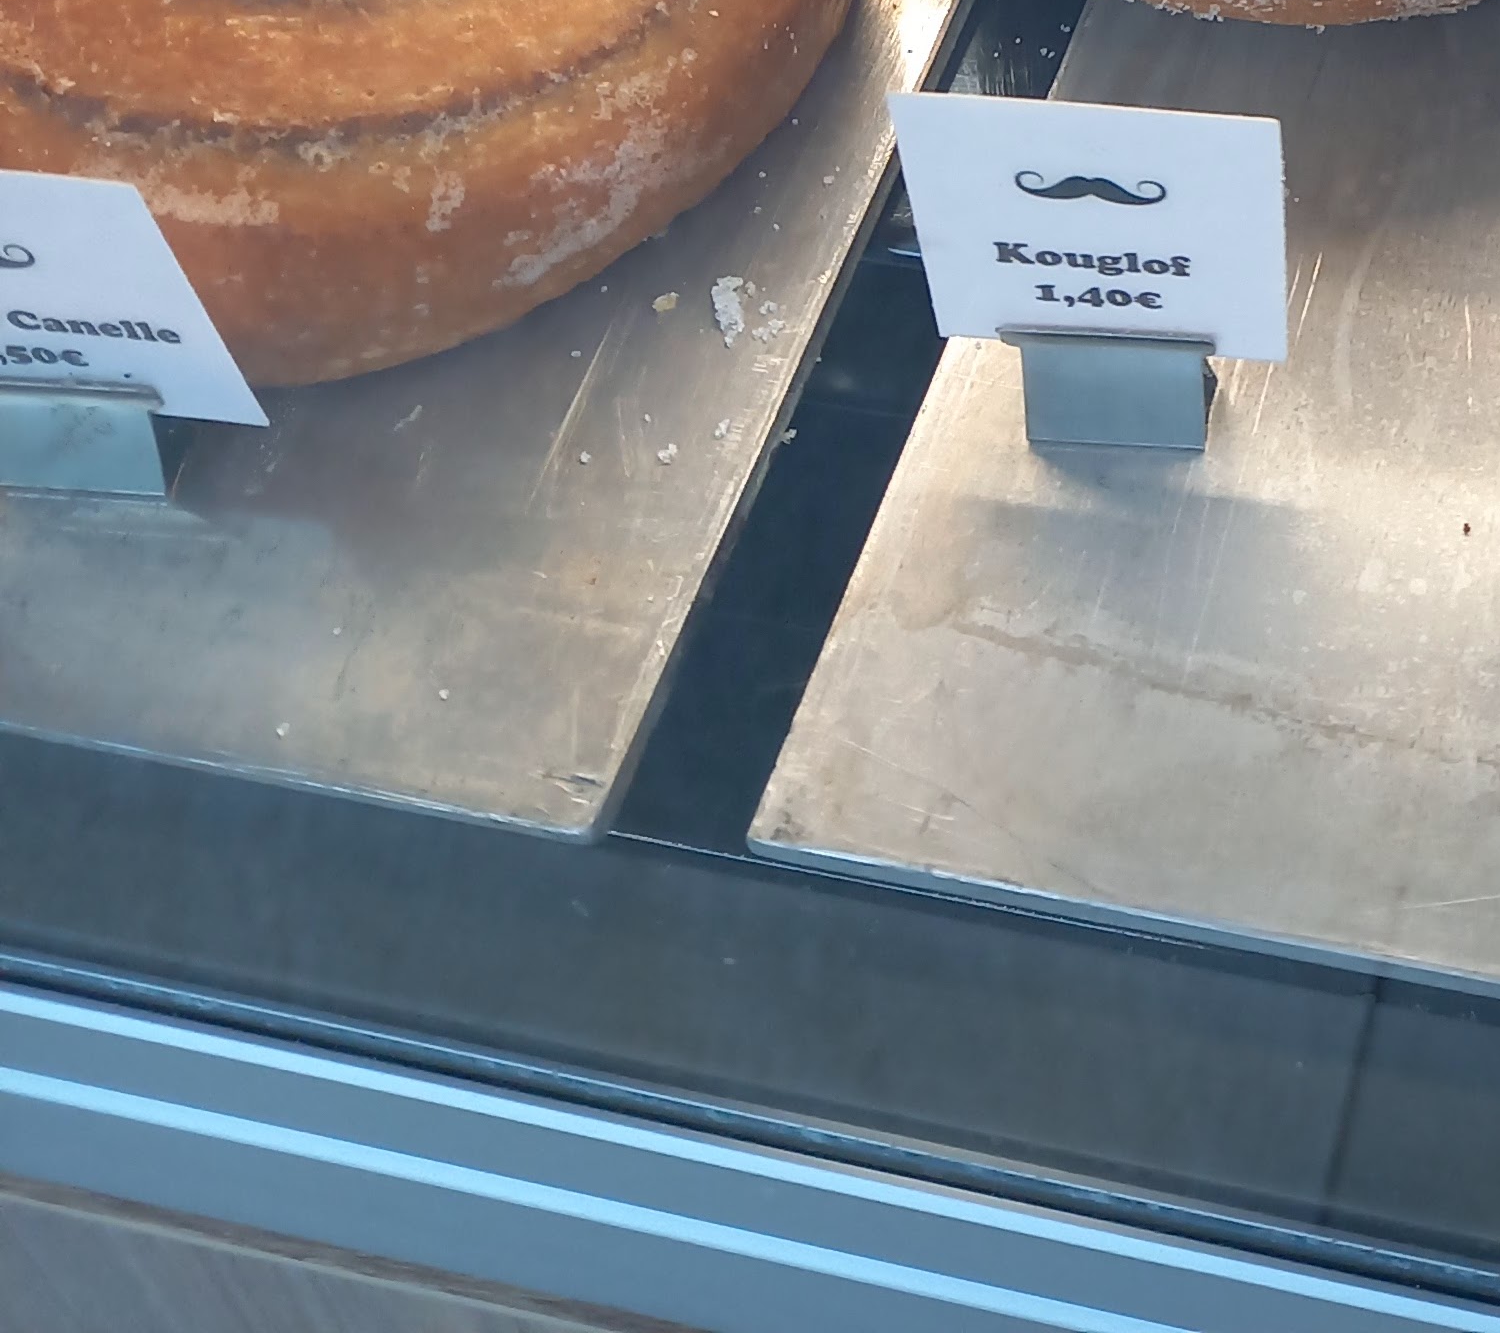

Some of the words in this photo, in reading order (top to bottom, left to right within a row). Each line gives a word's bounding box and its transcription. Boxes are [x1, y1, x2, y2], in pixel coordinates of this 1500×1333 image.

[993, 242, 1191, 277] Kouglof
[1034, 284, 1163, 309] 1,40€
[7, 310, 181, 344] Canelle
